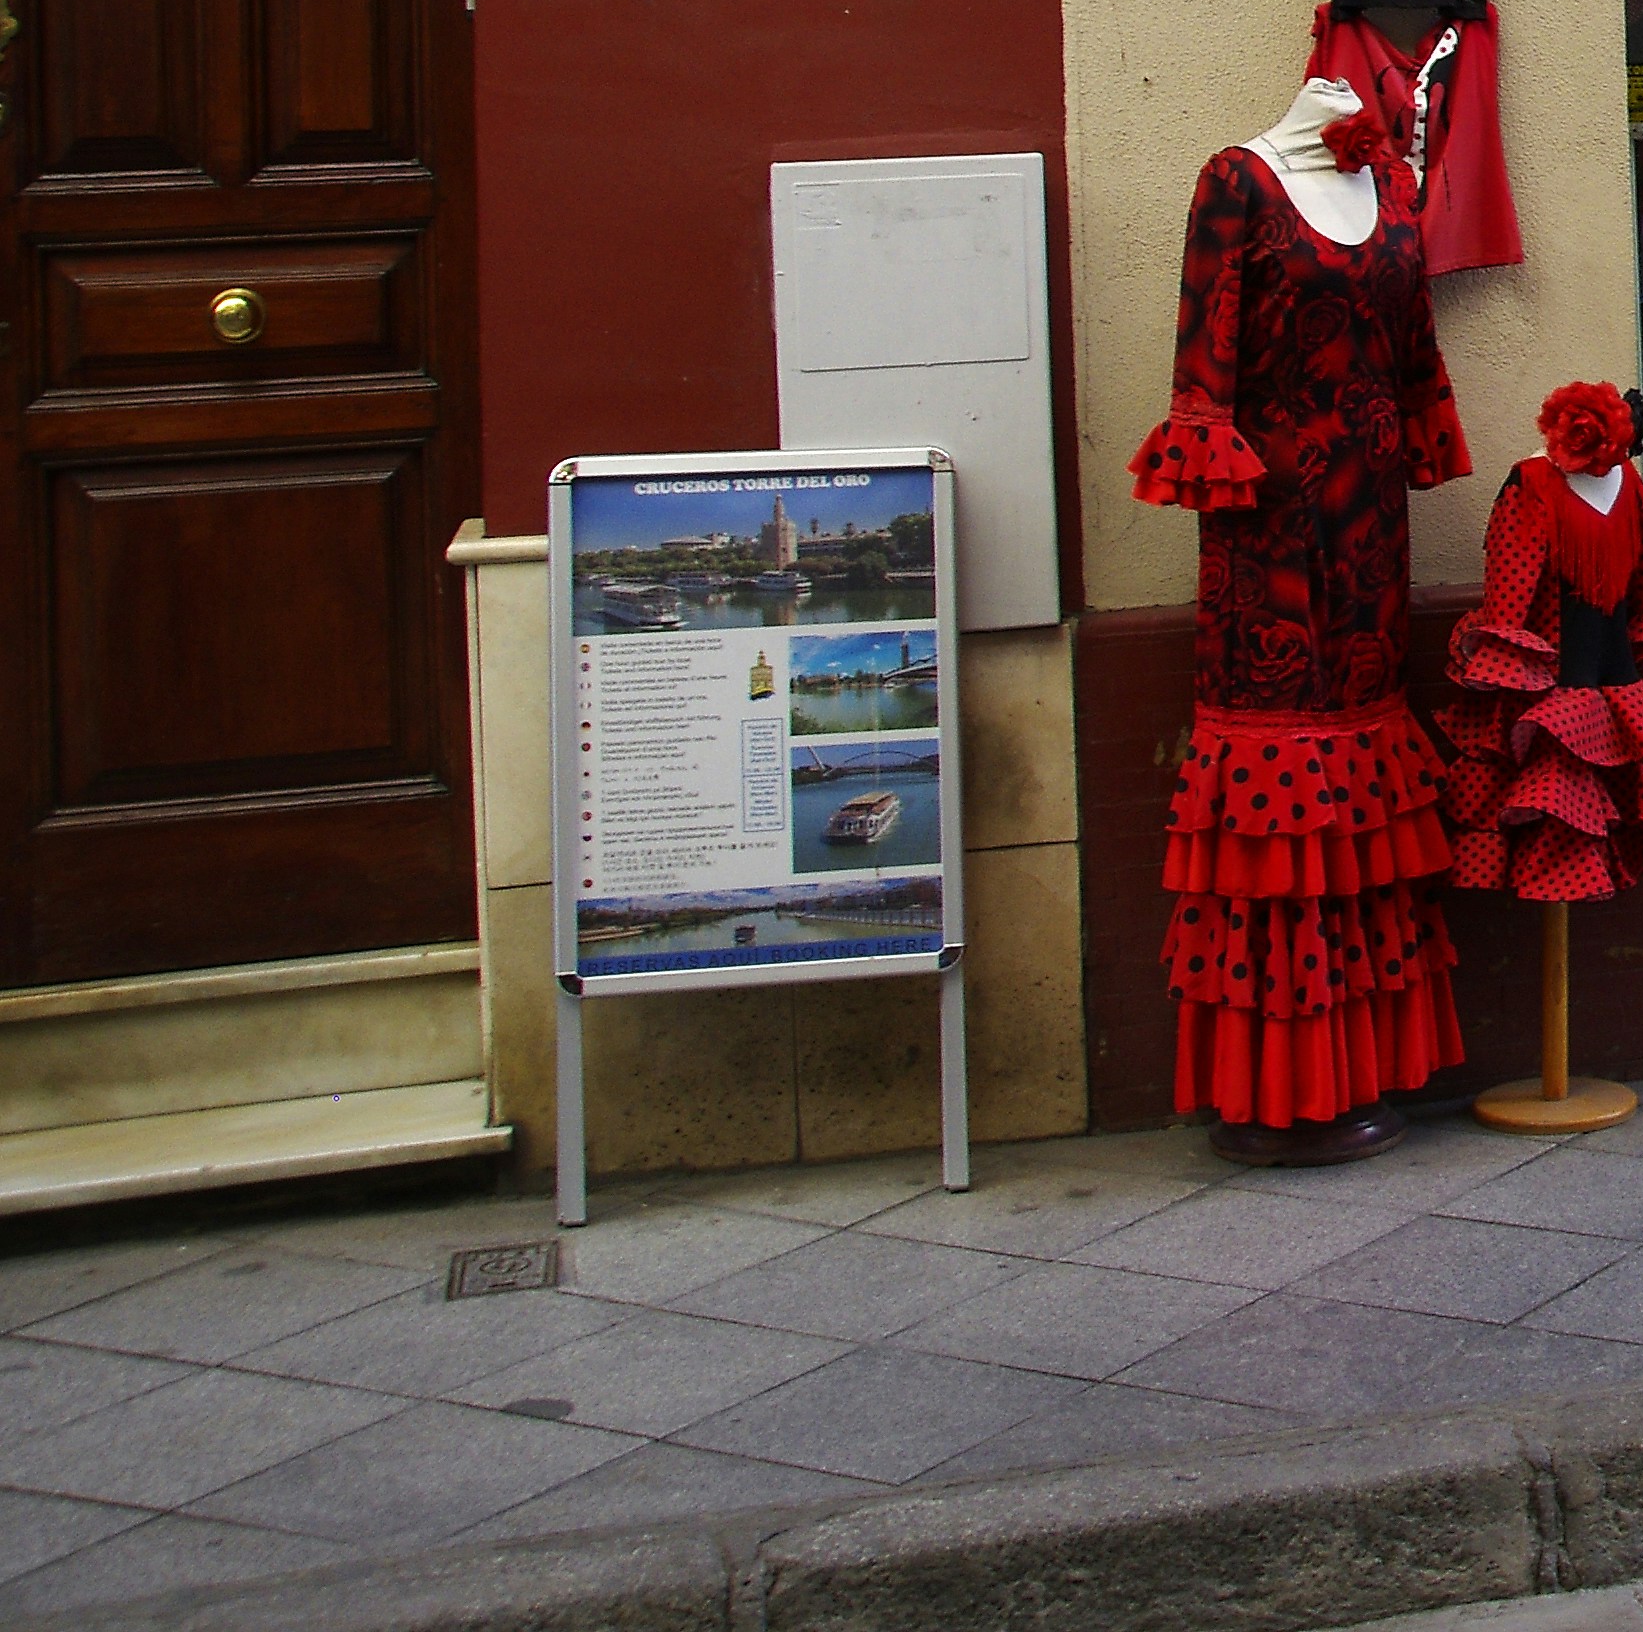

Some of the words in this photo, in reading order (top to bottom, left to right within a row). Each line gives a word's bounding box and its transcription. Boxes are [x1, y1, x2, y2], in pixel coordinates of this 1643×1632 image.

[634, 479, 730, 496] CRUCEROS
[733, 476, 794, 492] TORRE
[796, 475, 831, 489] DEL
[833, 473, 871, 487] ORO
[588, 955, 699, 974] RESERVAS
[772, 941, 868, 962] BOOKING
[876, 937, 932, 955] HERE
